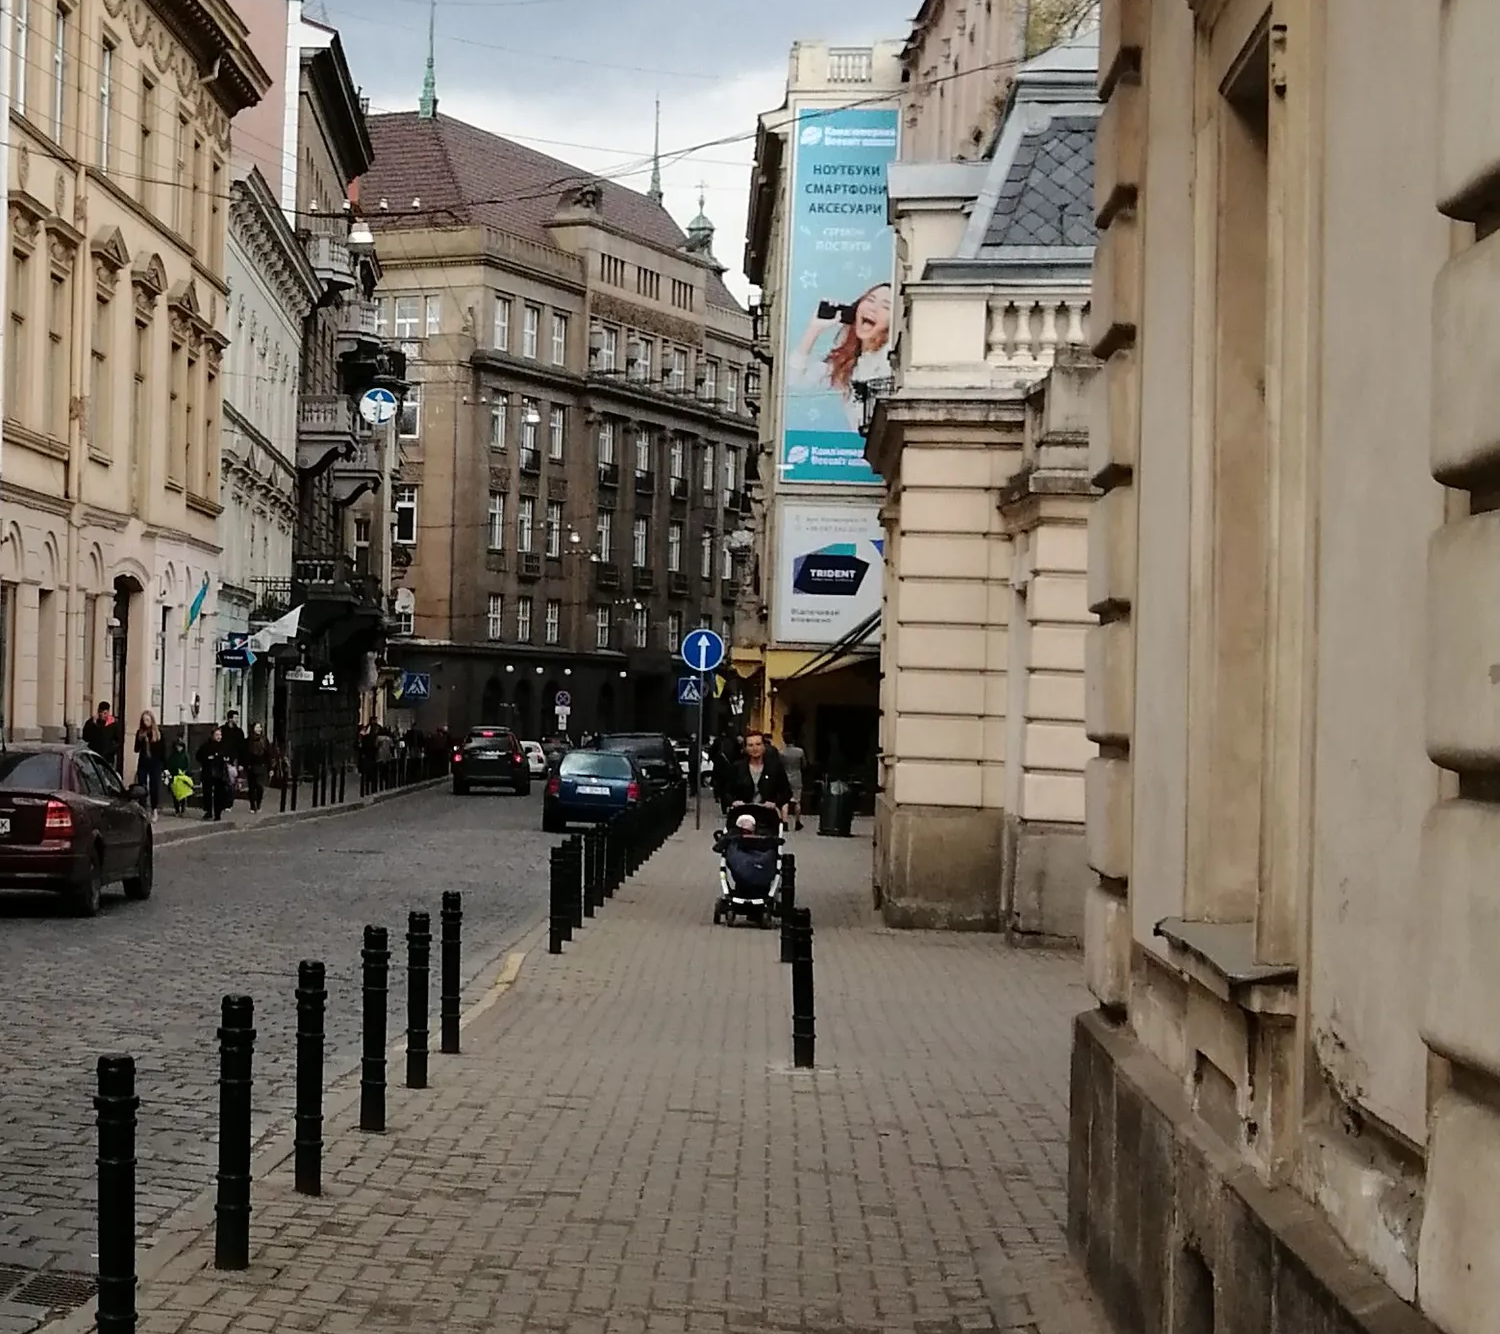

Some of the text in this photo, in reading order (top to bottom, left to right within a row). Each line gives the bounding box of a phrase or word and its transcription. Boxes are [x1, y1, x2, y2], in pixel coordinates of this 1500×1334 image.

[813, 164, 881, 176] НОУТБУКИ
[805, 183, 887, 195] СМАРТФОНИ
[808, 202, 882, 214] АКСЕСУАРИ
[810, 569, 856, 578] TRIDENT
